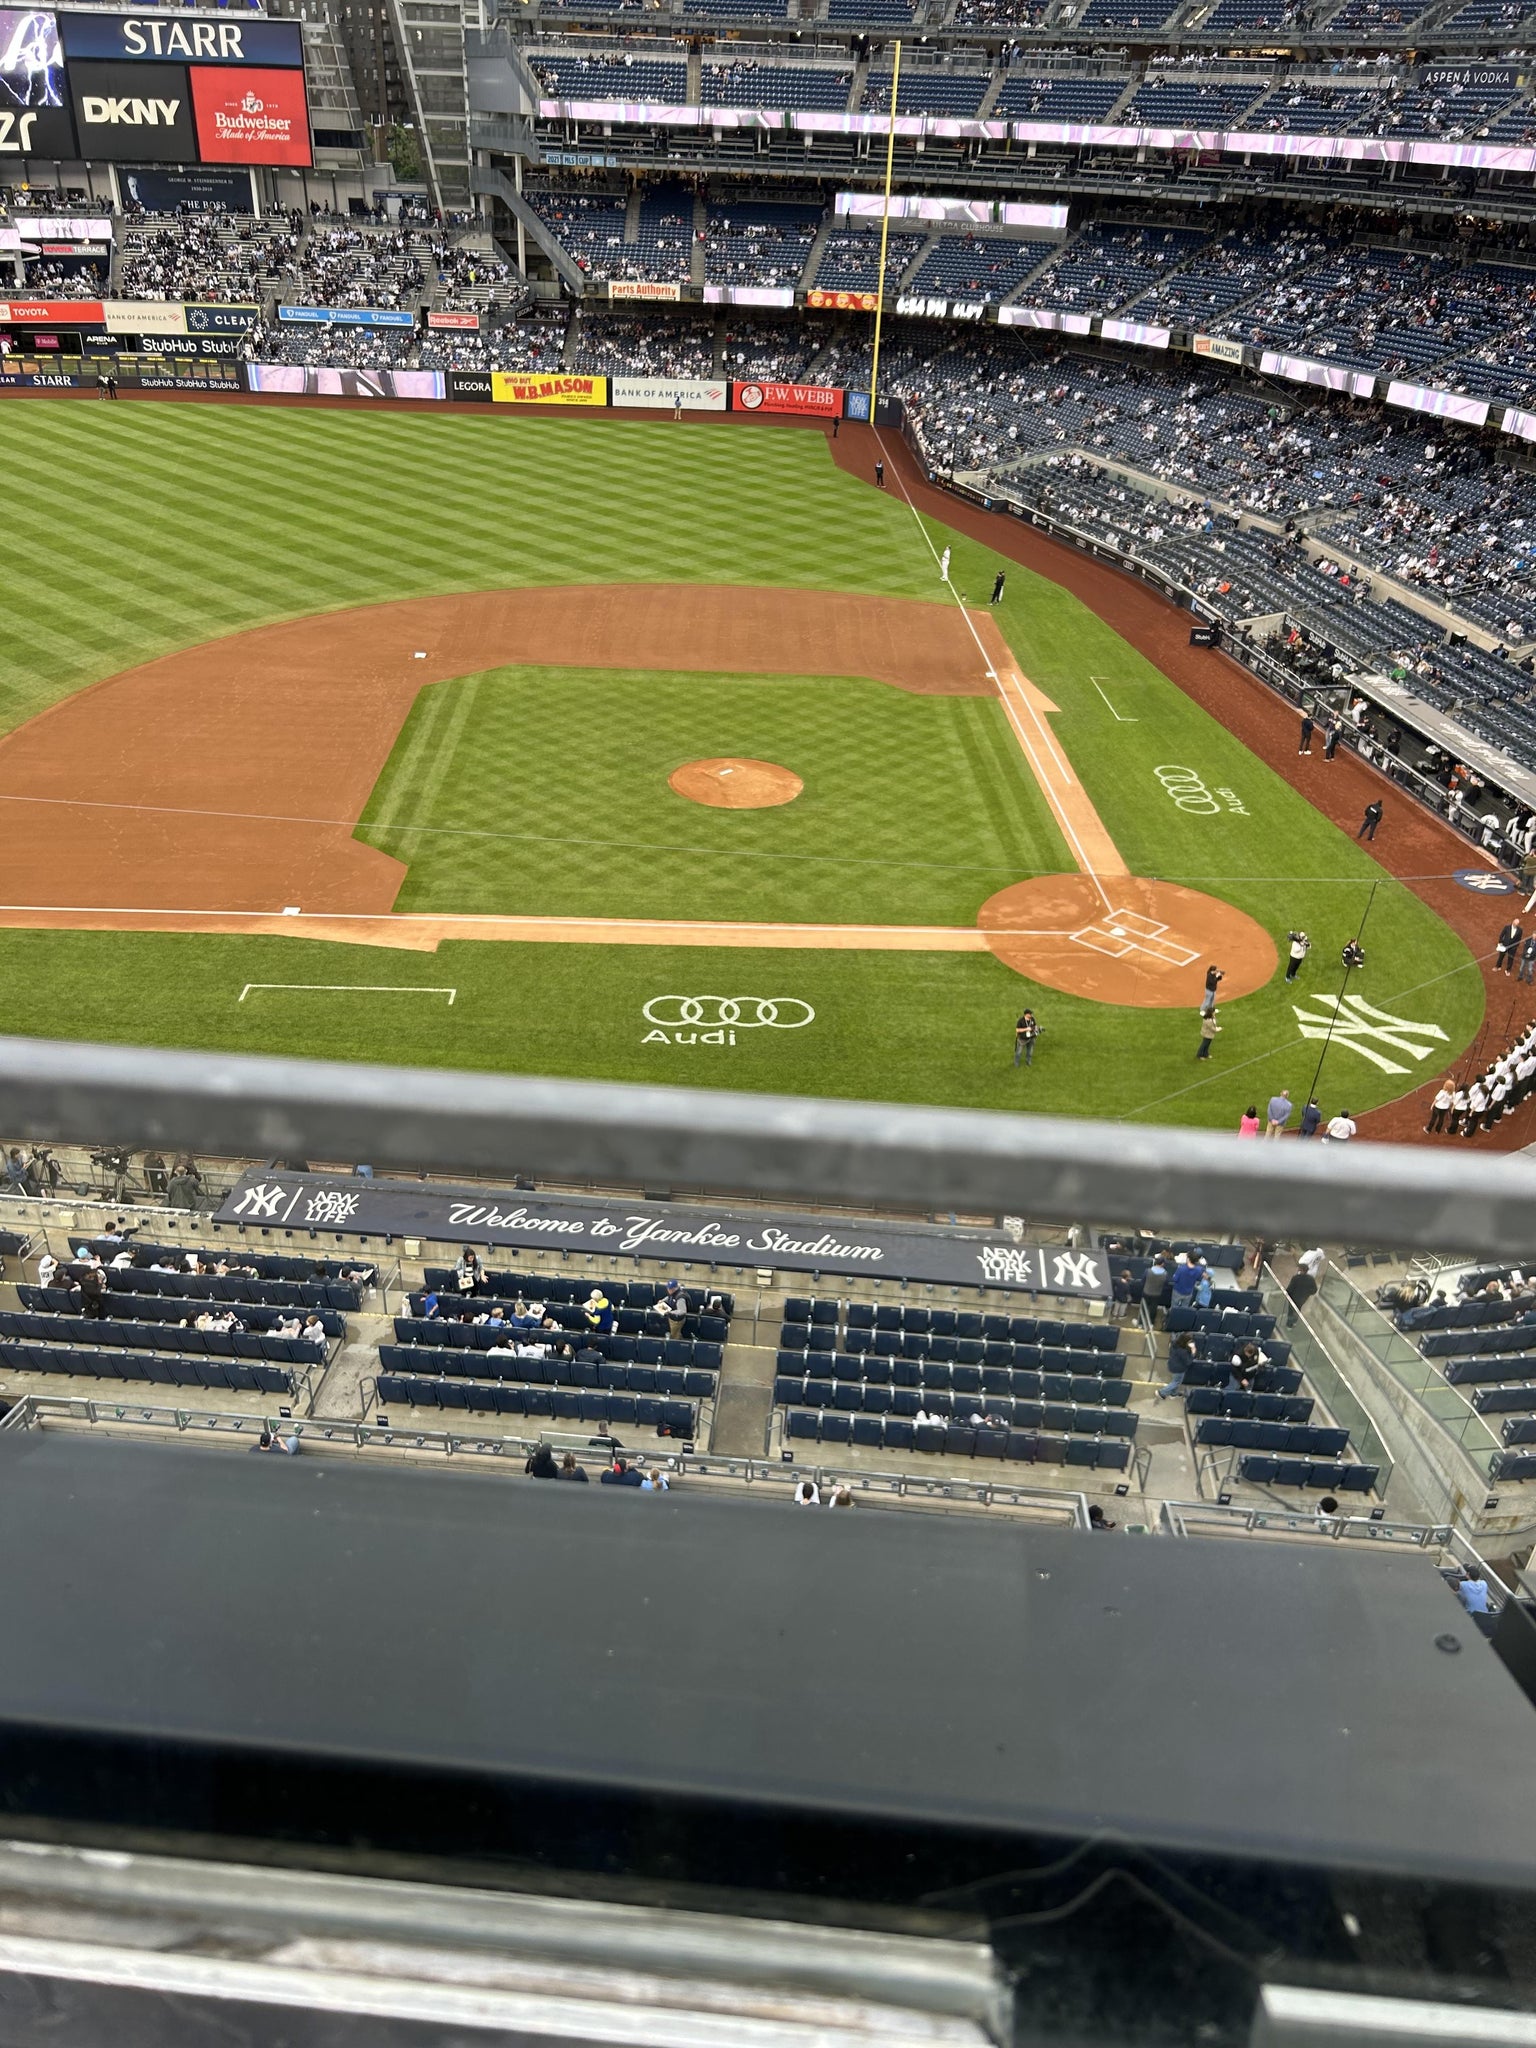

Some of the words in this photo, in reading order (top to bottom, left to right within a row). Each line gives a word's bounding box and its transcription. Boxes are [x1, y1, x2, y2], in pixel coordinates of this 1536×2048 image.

[123, 20, 245, 58] STARR
[1425, 72, 1461, 83] ASPEN
[1473, 72, 1510, 83] VODKA
[82, 96, 180, 126] DKNY
[214, 111, 292, 130] Budweiser
[215, 128, 244, 139] Made
[245, 130, 255, 141] of
[254, 130, 291, 141] America
[203, 200, 227, 210] BOSS
[612, 285, 635, 294] Parts
[636, 284, 676, 296] Authority
[13, 308, 49, 316] TOYOTA
[215, 316, 254, 327] CLEAR
[430, 316, 459, 324] Reebok
[142, 339, 197, 353] StubHub
[202, 340, 238, 354] StubH
[1211, 343, 1240, 360] AMAZING
[33, 375, 72, 386] STARR
[141, 378, 174, 388] StubHub
[176, 379, 207, 388] StubHub
[209, 380, 240, 390] StubHub
[454, 381, 491, 392] LEGORA
[615, 389, 641, 397] BANK
[658, 390, 702, 400] AMERICA
[764, 387, 790, 401] F.W.
[794, 389, 834, 405] WEBB
[851, 408, 866, 416] LIFE
[1308, 632, 1327, 650] StubHub
[1214, 787, 1250, 816] Audi
[641, 1029, 736, 1046] Audi
[315, 1191, 360, 1202] NEW
[307, 1199, 360, 1215] YORK
[304, 1210, 346, 1224] LIFE
[448, 1202, 585, 1234] Welcome
[590, 1217, 623, 1237] to
[619, 1215, 740, 1250] Yankee
[746, 1227, 885, 1261] Stadium
[983, 1246, 1026, 1259] NEW
[976, 1255, 1032, 1274] YORK
[985, 1267, 1027, 1283] LIFE
